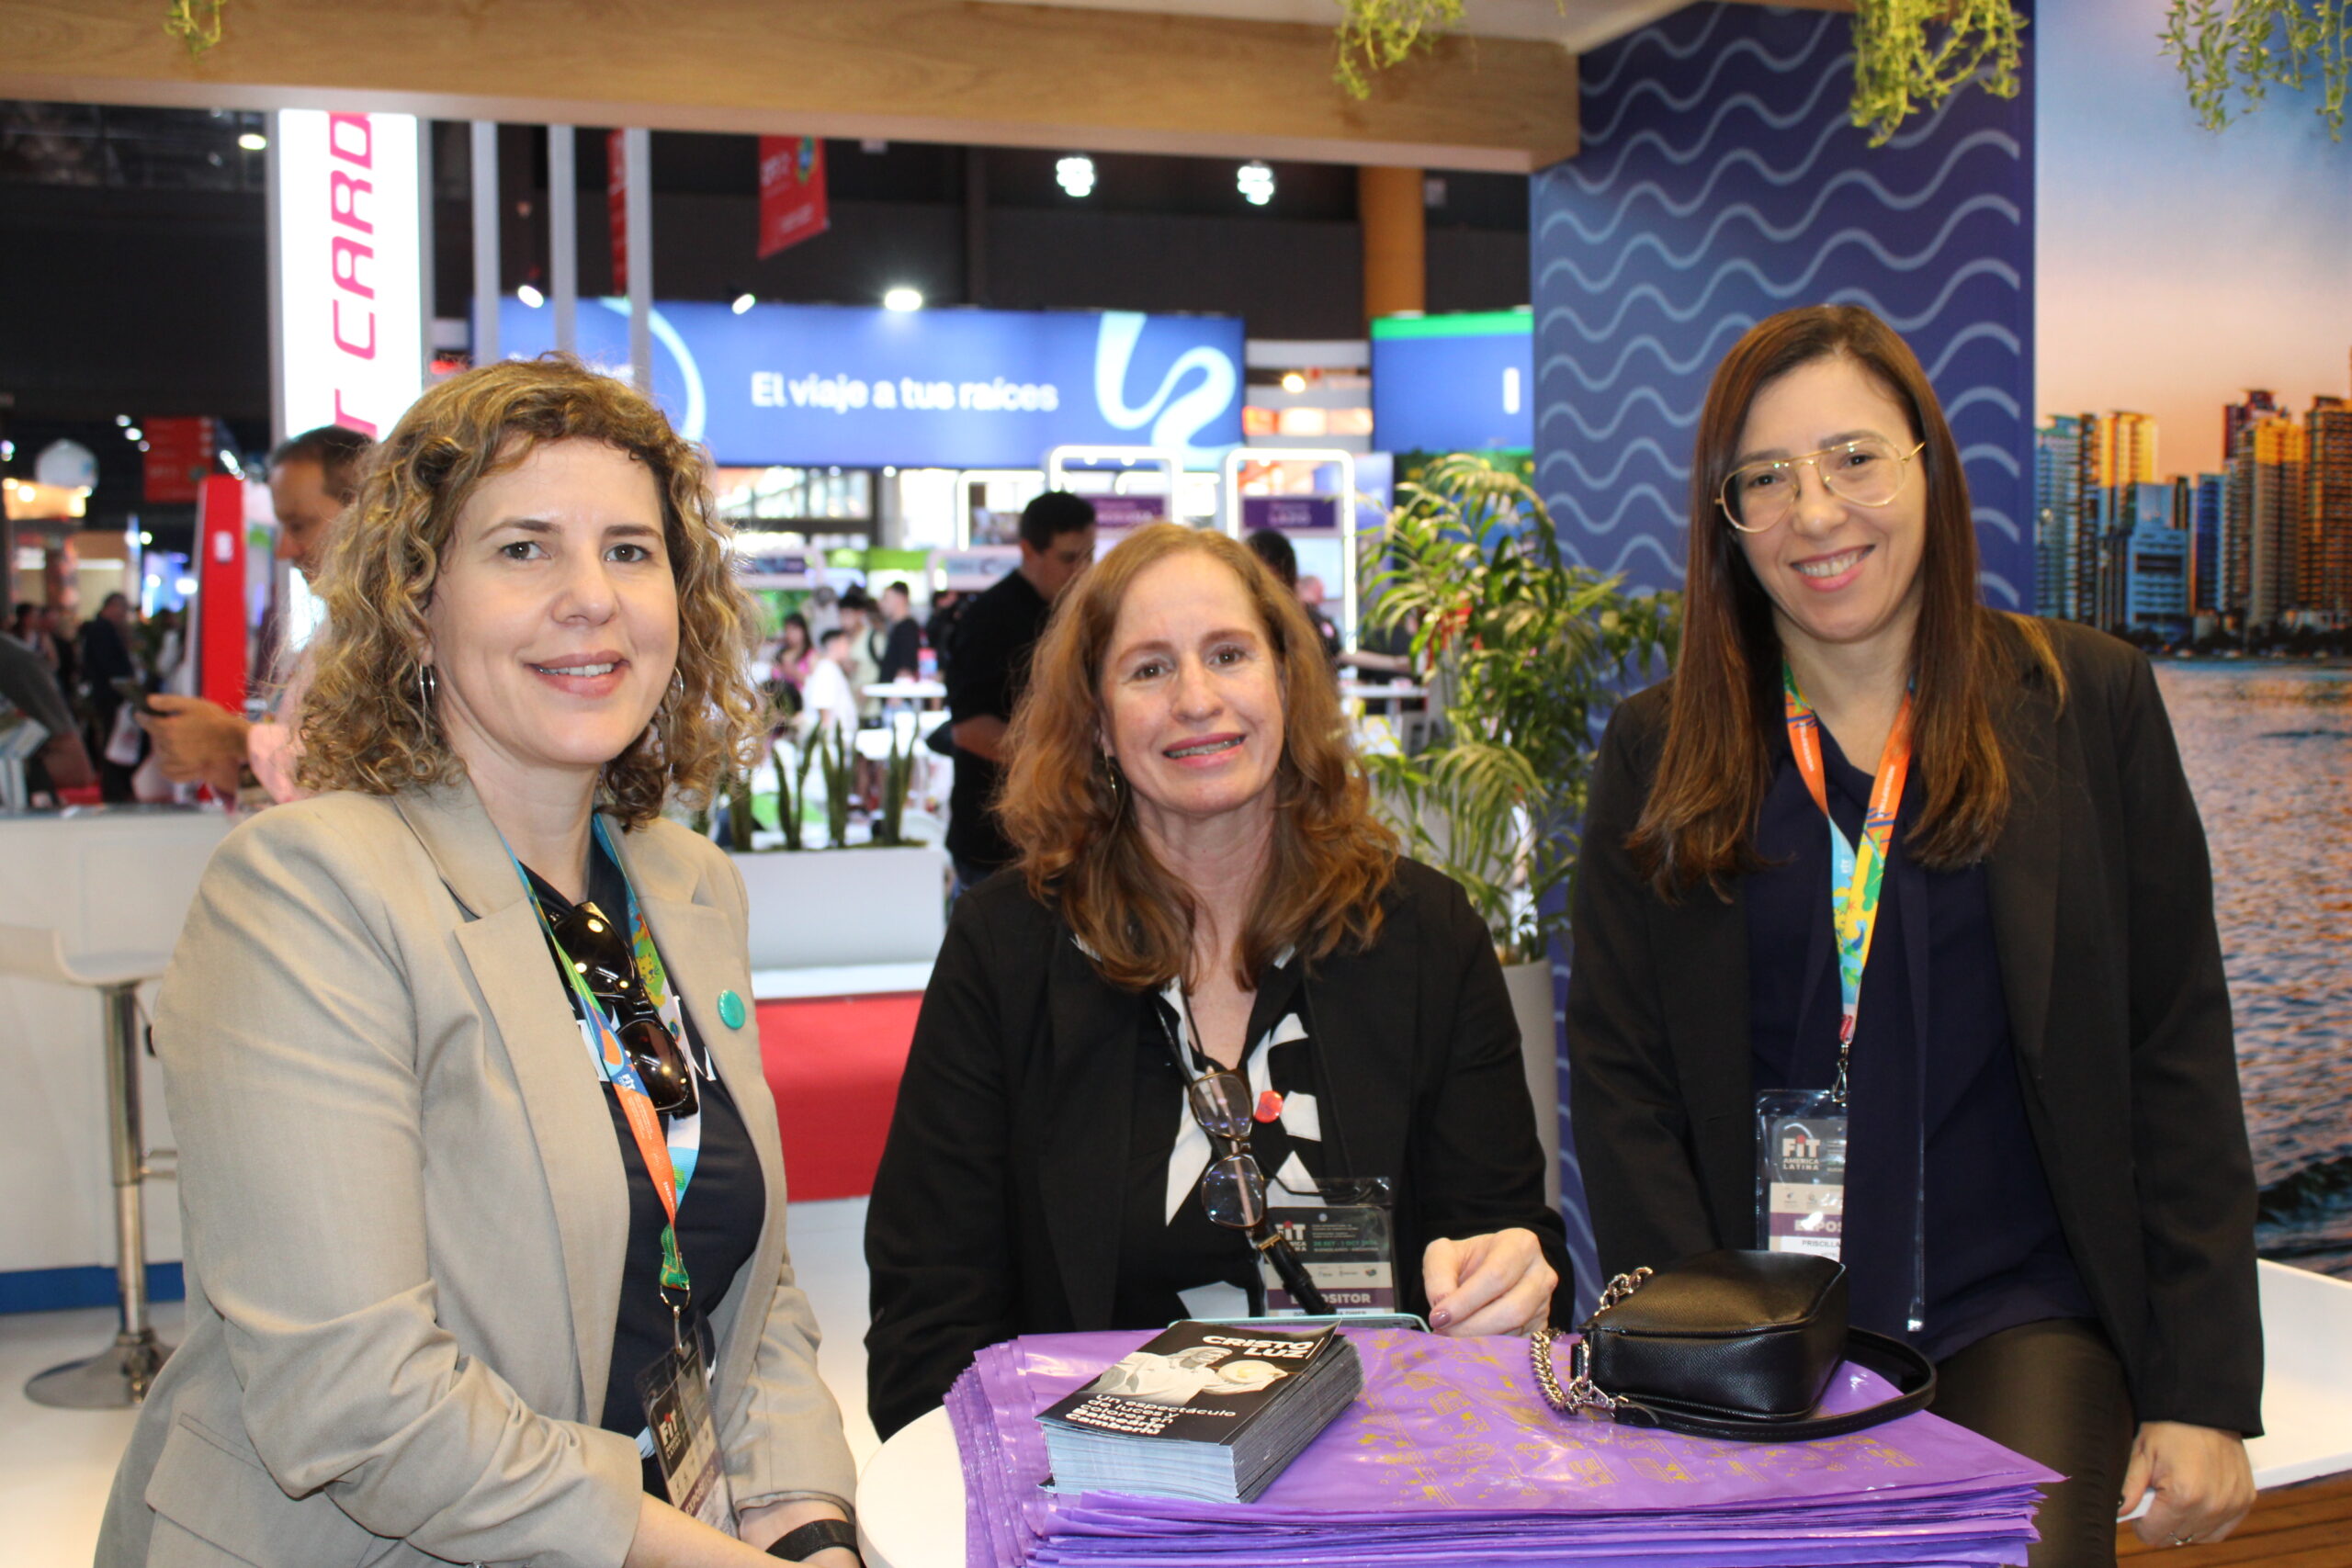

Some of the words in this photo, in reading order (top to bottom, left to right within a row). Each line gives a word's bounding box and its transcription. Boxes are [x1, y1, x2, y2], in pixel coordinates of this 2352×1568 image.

[328, 110, 377, 360] CARD
[751, 371, 787, 407] El
[788, 372, 869, 414] viaje
[872, 379, 898, 409] a
[899, 376, 956, 410] tus
[958, 376, 1058, 412] raíces
[1290, 1292, 1371, 1304] EOSITOR
[1203, 1335, 1314, 1350] CRISTO
[1243, 1347, 1308, 1359] LUZ
[1080, 1404, 1148, 1421] colores
[1149, 1416, 1173, 1425] en
[1088, 1399, 1112, 1408] de
[1114, 1404, 1164, 1417] luces
[1163, 1412, 1180, 1420] y
[1096, 1393, 1121, 1404] Un
[1125, 1400, 1237, 1417] espectáculo
